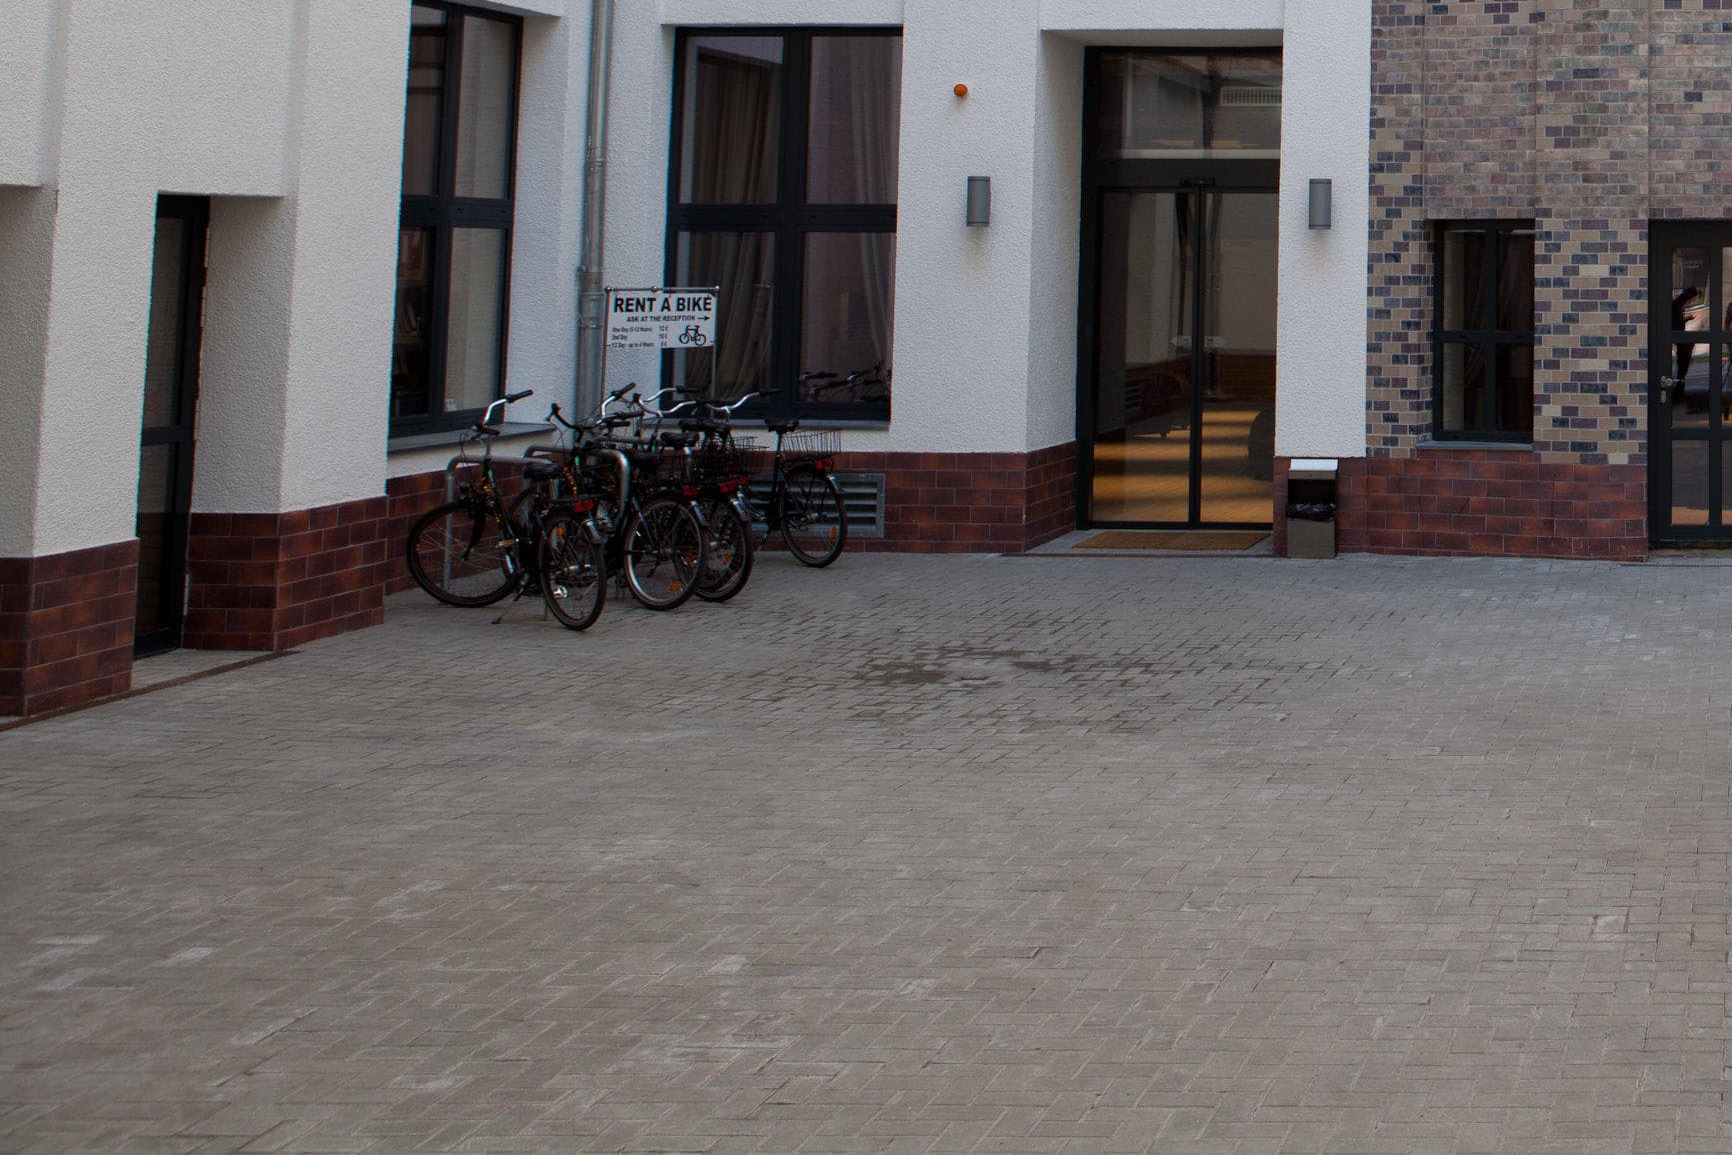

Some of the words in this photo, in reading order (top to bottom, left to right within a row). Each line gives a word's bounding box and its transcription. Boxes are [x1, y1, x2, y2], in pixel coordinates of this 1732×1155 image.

[615, 297, 656, 312] RENT
[661, 297, 671, 312] A
[676, 297, 712, 312] BIKE
